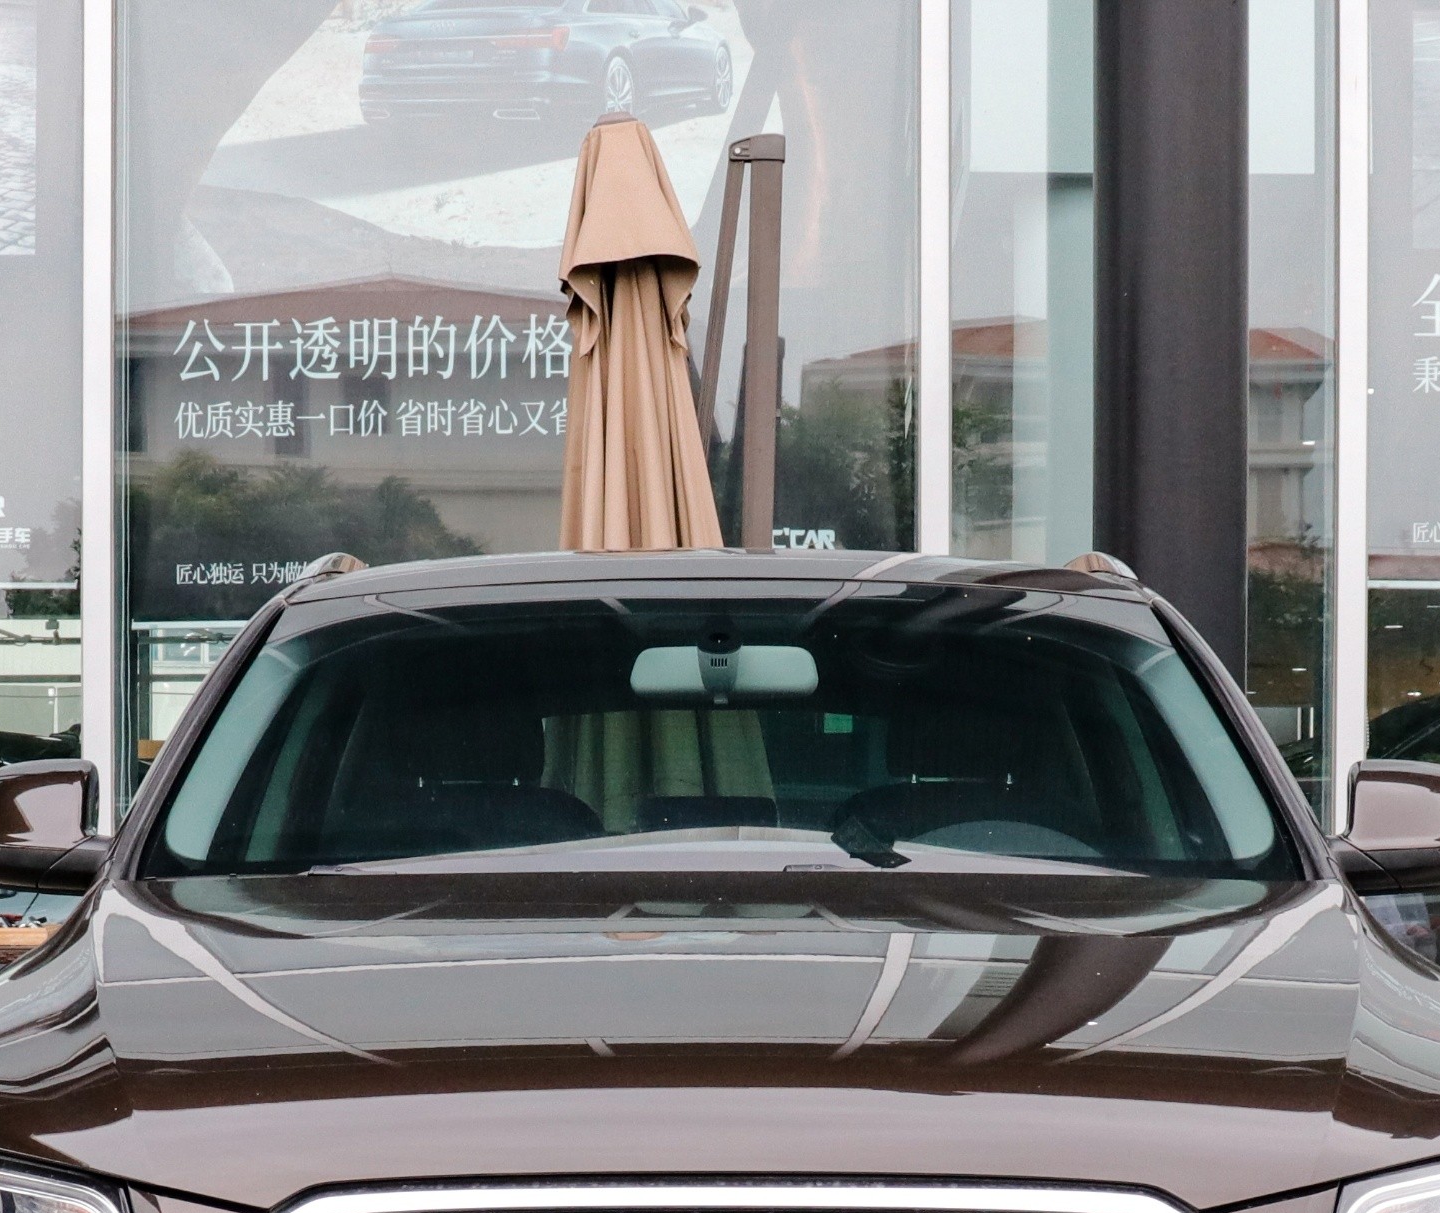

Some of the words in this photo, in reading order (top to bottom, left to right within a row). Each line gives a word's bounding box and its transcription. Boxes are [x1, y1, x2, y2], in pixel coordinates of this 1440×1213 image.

[173, 313, 572, 382] 公开透明的价格
[174, 399, 388, 440] 优质实惠一口价
[175, 562, 245, 585] 匠心独运
[250, 561, 308, 584] 只为做
